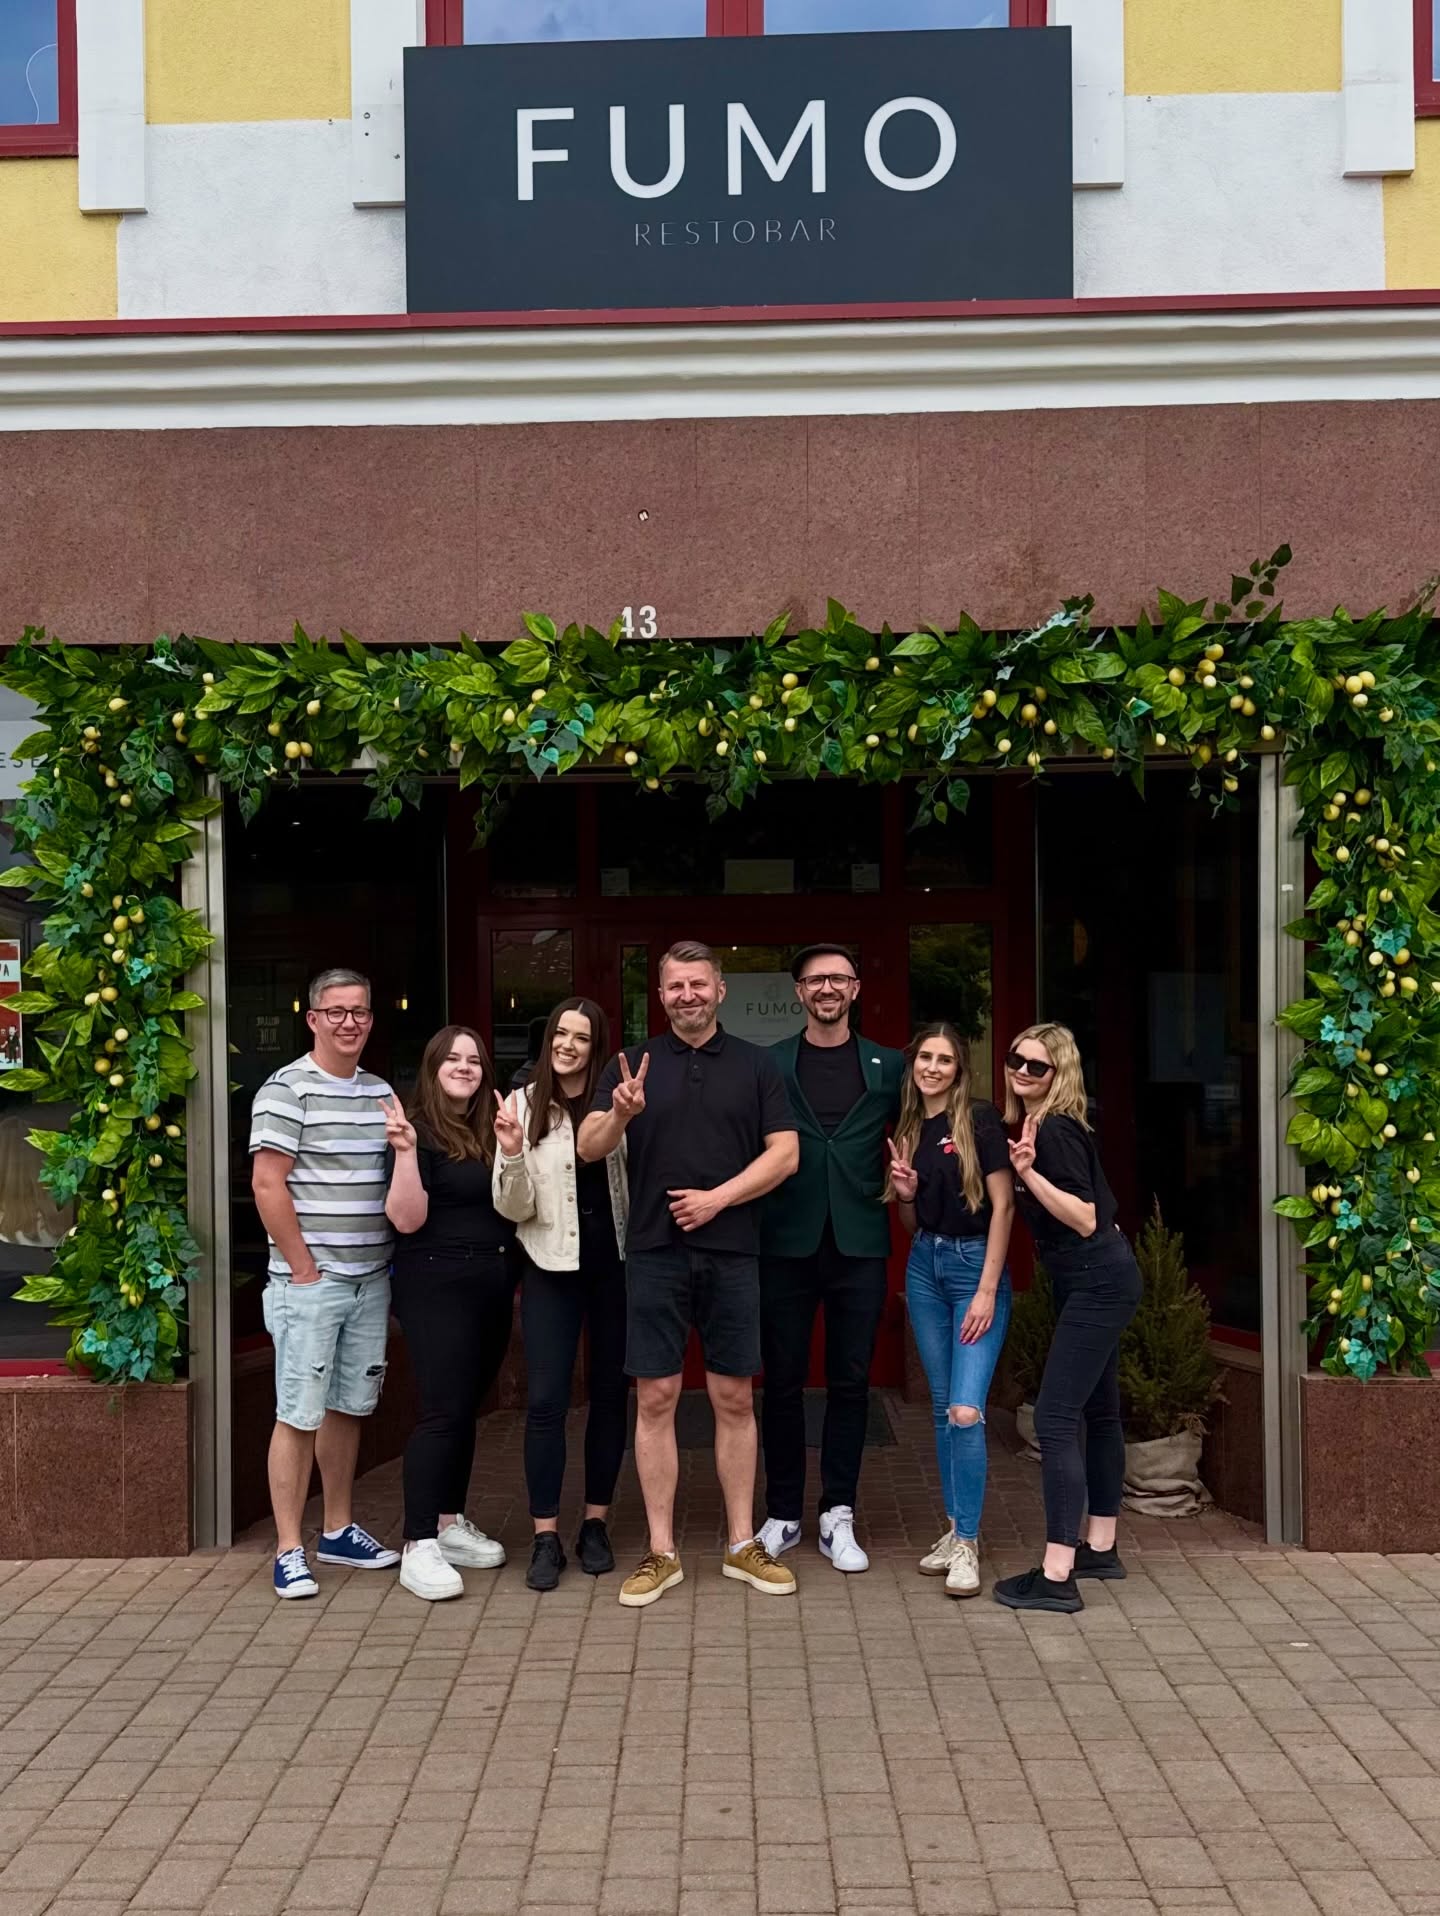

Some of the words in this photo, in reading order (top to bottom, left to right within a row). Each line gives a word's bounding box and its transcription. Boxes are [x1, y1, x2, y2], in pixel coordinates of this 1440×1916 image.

[517, 96, 957, 201] FUMO
[635, 217, 836, 246] RESTOBAR
[620, 604, 657, 638] 43
[746, 1002, 803, 1016] FUMO
